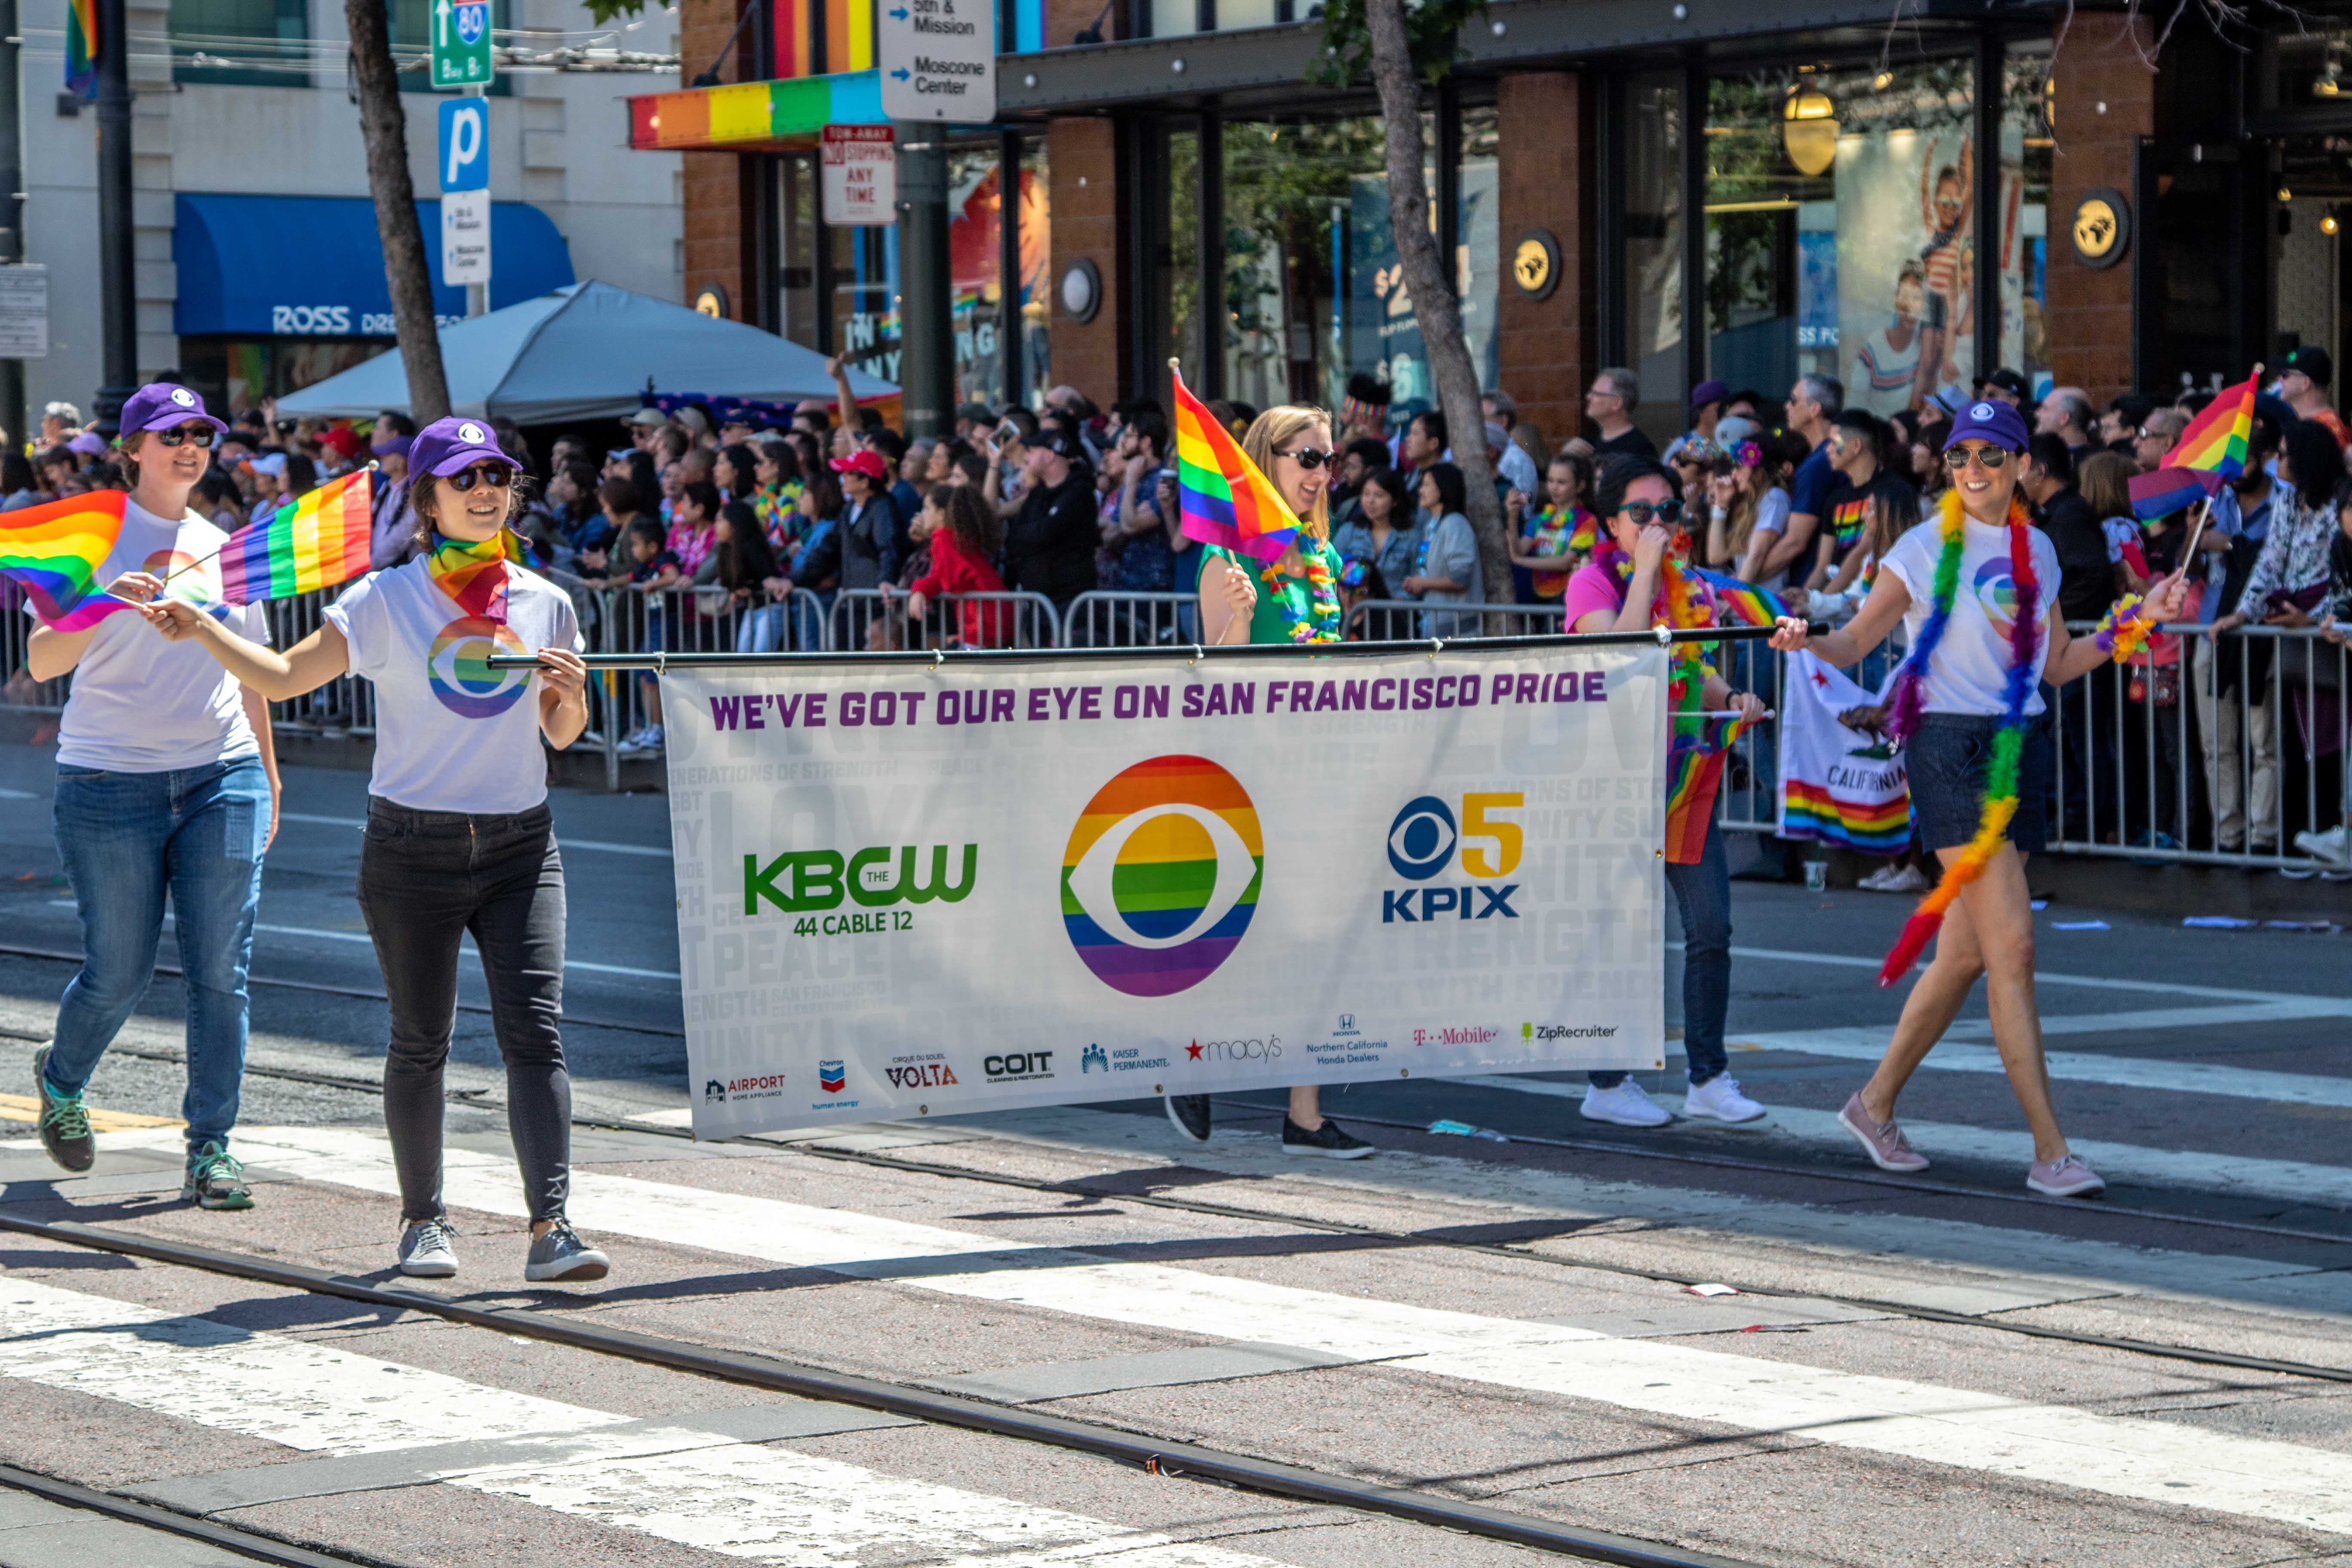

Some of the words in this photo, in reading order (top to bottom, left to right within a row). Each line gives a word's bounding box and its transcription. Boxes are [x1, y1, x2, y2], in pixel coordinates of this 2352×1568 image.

[913, 0, 938, 12] 5th
[459, 6, 483, 35] 80
[914, 16, 975, 35] Mission
[915, 56, 985, 75] Moscone
[916, 76, 968, 93] Center
[824, 142, 843, 162] NO
[847, 167, 874, 182] ANY
[845, 187, 876, 202] TIME
[273, 306, 350, 334] ROSS
[361, 314, 396, 333] DRE
[710, 693, 827, 730] WE'VE
[839, 691, 926, 726] GOT
[936, 689, 1015, 725] OUR
[1028, 686, 1102, 721] EYE
[1114, 685, 1170, 719] ON
[1182, 682, 1256, 718] SAN
[1267, 674, 1481, 714] FRANCISCO
[1491, 671, 1608, 705] PRIDE
[1461, 792, 1525, 878] 5
[744, 844, 978, 916] KBCW
[867, 871, 889, 883] THE
[1383, 884, 1521, 923] KPIX
[793, 917, 818, 937] 44
[822, 912, 887, 935] CABLE
[892, 910, 913, 930] 12
[1537, 1025, 1617, 1042] ZipRecruiter
[1112, 1049, 1139, 1059] KAISER
[1207, 1033, 1282, 1064] macy's
[1307, 1043, 1345, 1053] Northern
[1347, 1039, 1388, 1051] California
[893, 1054, 916, 1064] CIRQUE
[984, 1050, 1054, 1076] COIT
[1114, 1058, 1168, 1072] PERMANENTE
[1317, 1054, 1345, 1065] Honda
[1348, 1053, 1379, 1064] Dealers
[728, 1075, 786, 1093] AIRPORT
[885, 1064, 959, 1090] VOLTA
[1018, 1073, 1055, 1081] RESTORATION
[750, 1090, 782, 1099] APPLIANCE
[812, 1102, 835, 1111] human
[836, 1100, 859, 1109] energy
